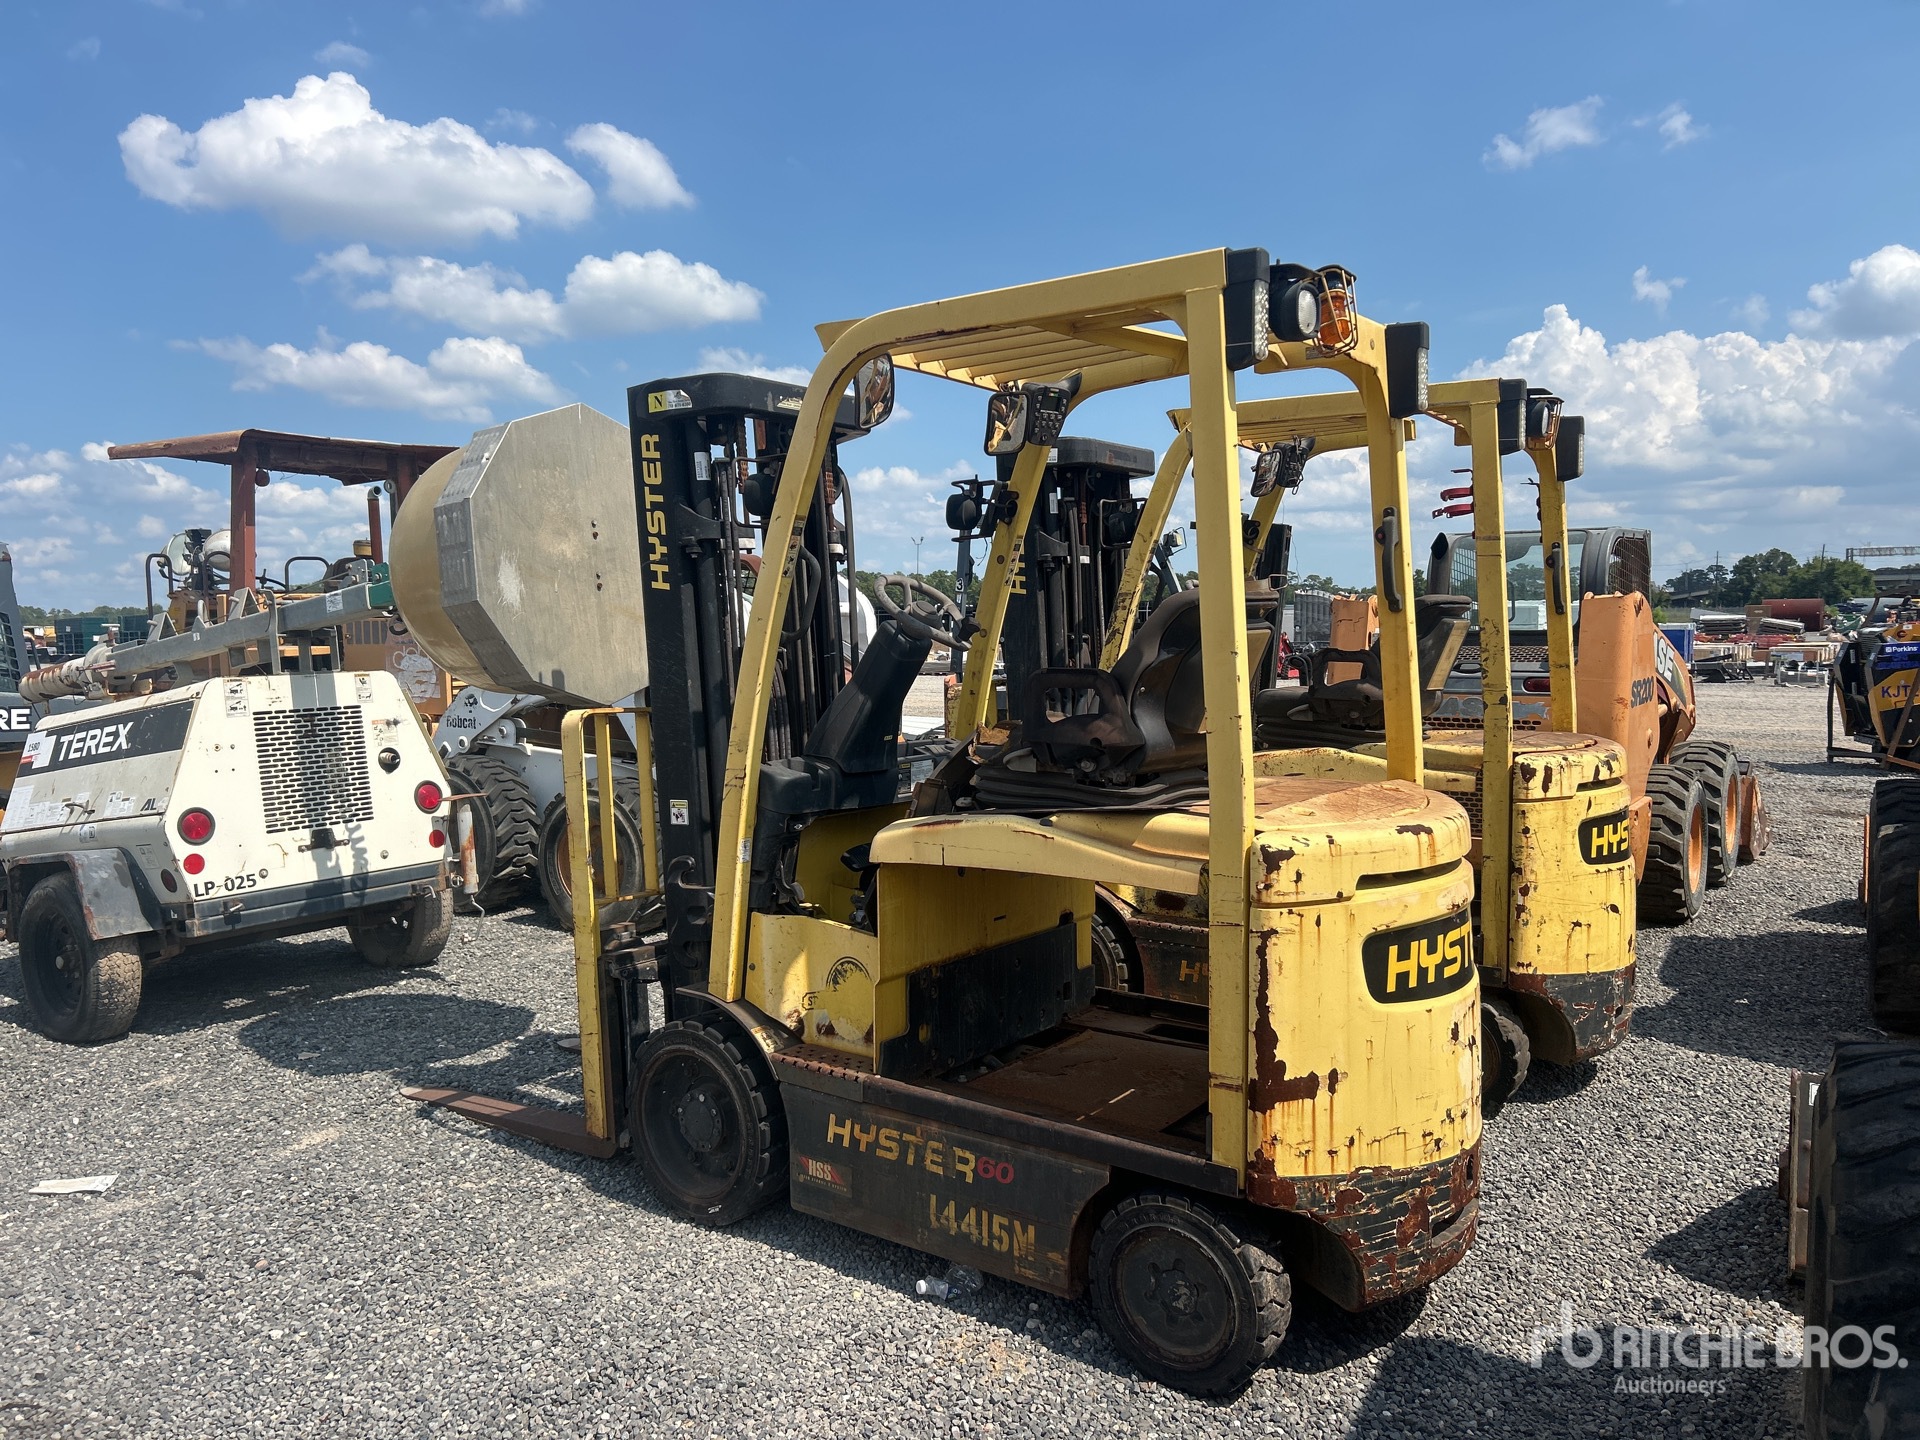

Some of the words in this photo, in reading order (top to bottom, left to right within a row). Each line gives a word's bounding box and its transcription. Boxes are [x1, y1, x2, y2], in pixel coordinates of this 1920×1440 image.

[653, 395, 664, 409] N
[640, 433, 671, 591] HYSTER
[956, 579, 963, 590] 3
[1892, 645, 1918, 653] Perkins
[446, 715, 477, 730] Bobcat
[58, 721, 135, 762] TEREX
[193, 873, 257, 898] LP-025
[826, 1113, 977, 1184] HYSTER
[976, 1156, 1015, 1185] 60
[808, 1158, 832, 1181] HSS
